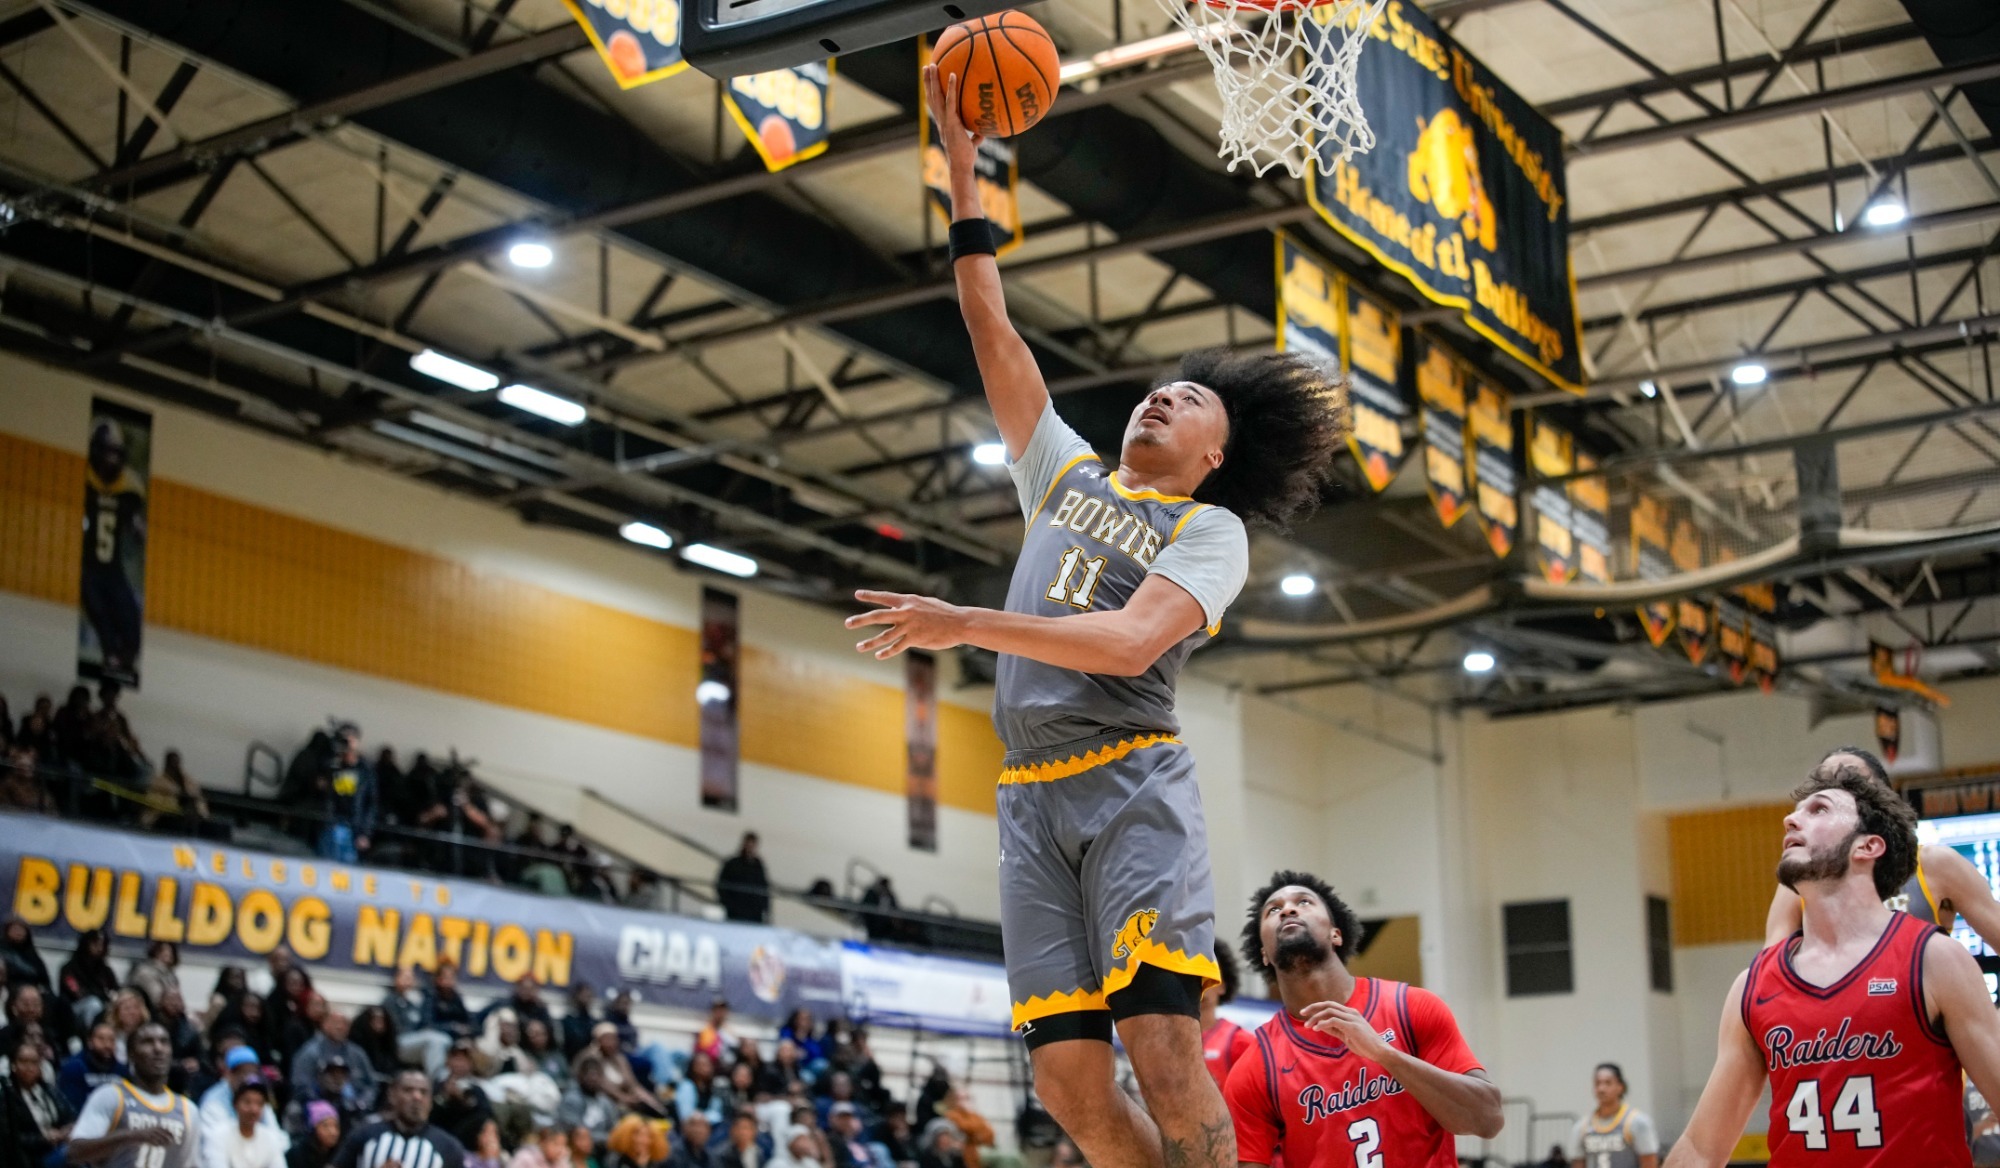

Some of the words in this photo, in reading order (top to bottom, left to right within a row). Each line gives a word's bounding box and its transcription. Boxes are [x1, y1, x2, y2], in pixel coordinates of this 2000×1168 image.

[1387, 1, 1450, 82] State
[1334, 158, 1411, 248] Home
[1471, 257, 1564, 367] Bulldogs
[95, 514, 118, 564] 5
[1049, 488, 1164, 571] BOWIE
[1045, 545, 1108, 610] 11
[172, 843, 378, 896] WELCOME
[410, 879, 450, 906] TO
[13, 856, 332, 960] BULLDOG
[353, 904, 574, 987] NATION
[617, 924, 722, 993] CIAA
[1868, 982, 1896, 991] PSAC
[1765, 1016, 1903, 1071] Raiders
[1298, 1066, 1406, 1125] Raiders
[1785, 1074, 1885, 1152] 44
[1346, 1115, 1385, 1168] 2
